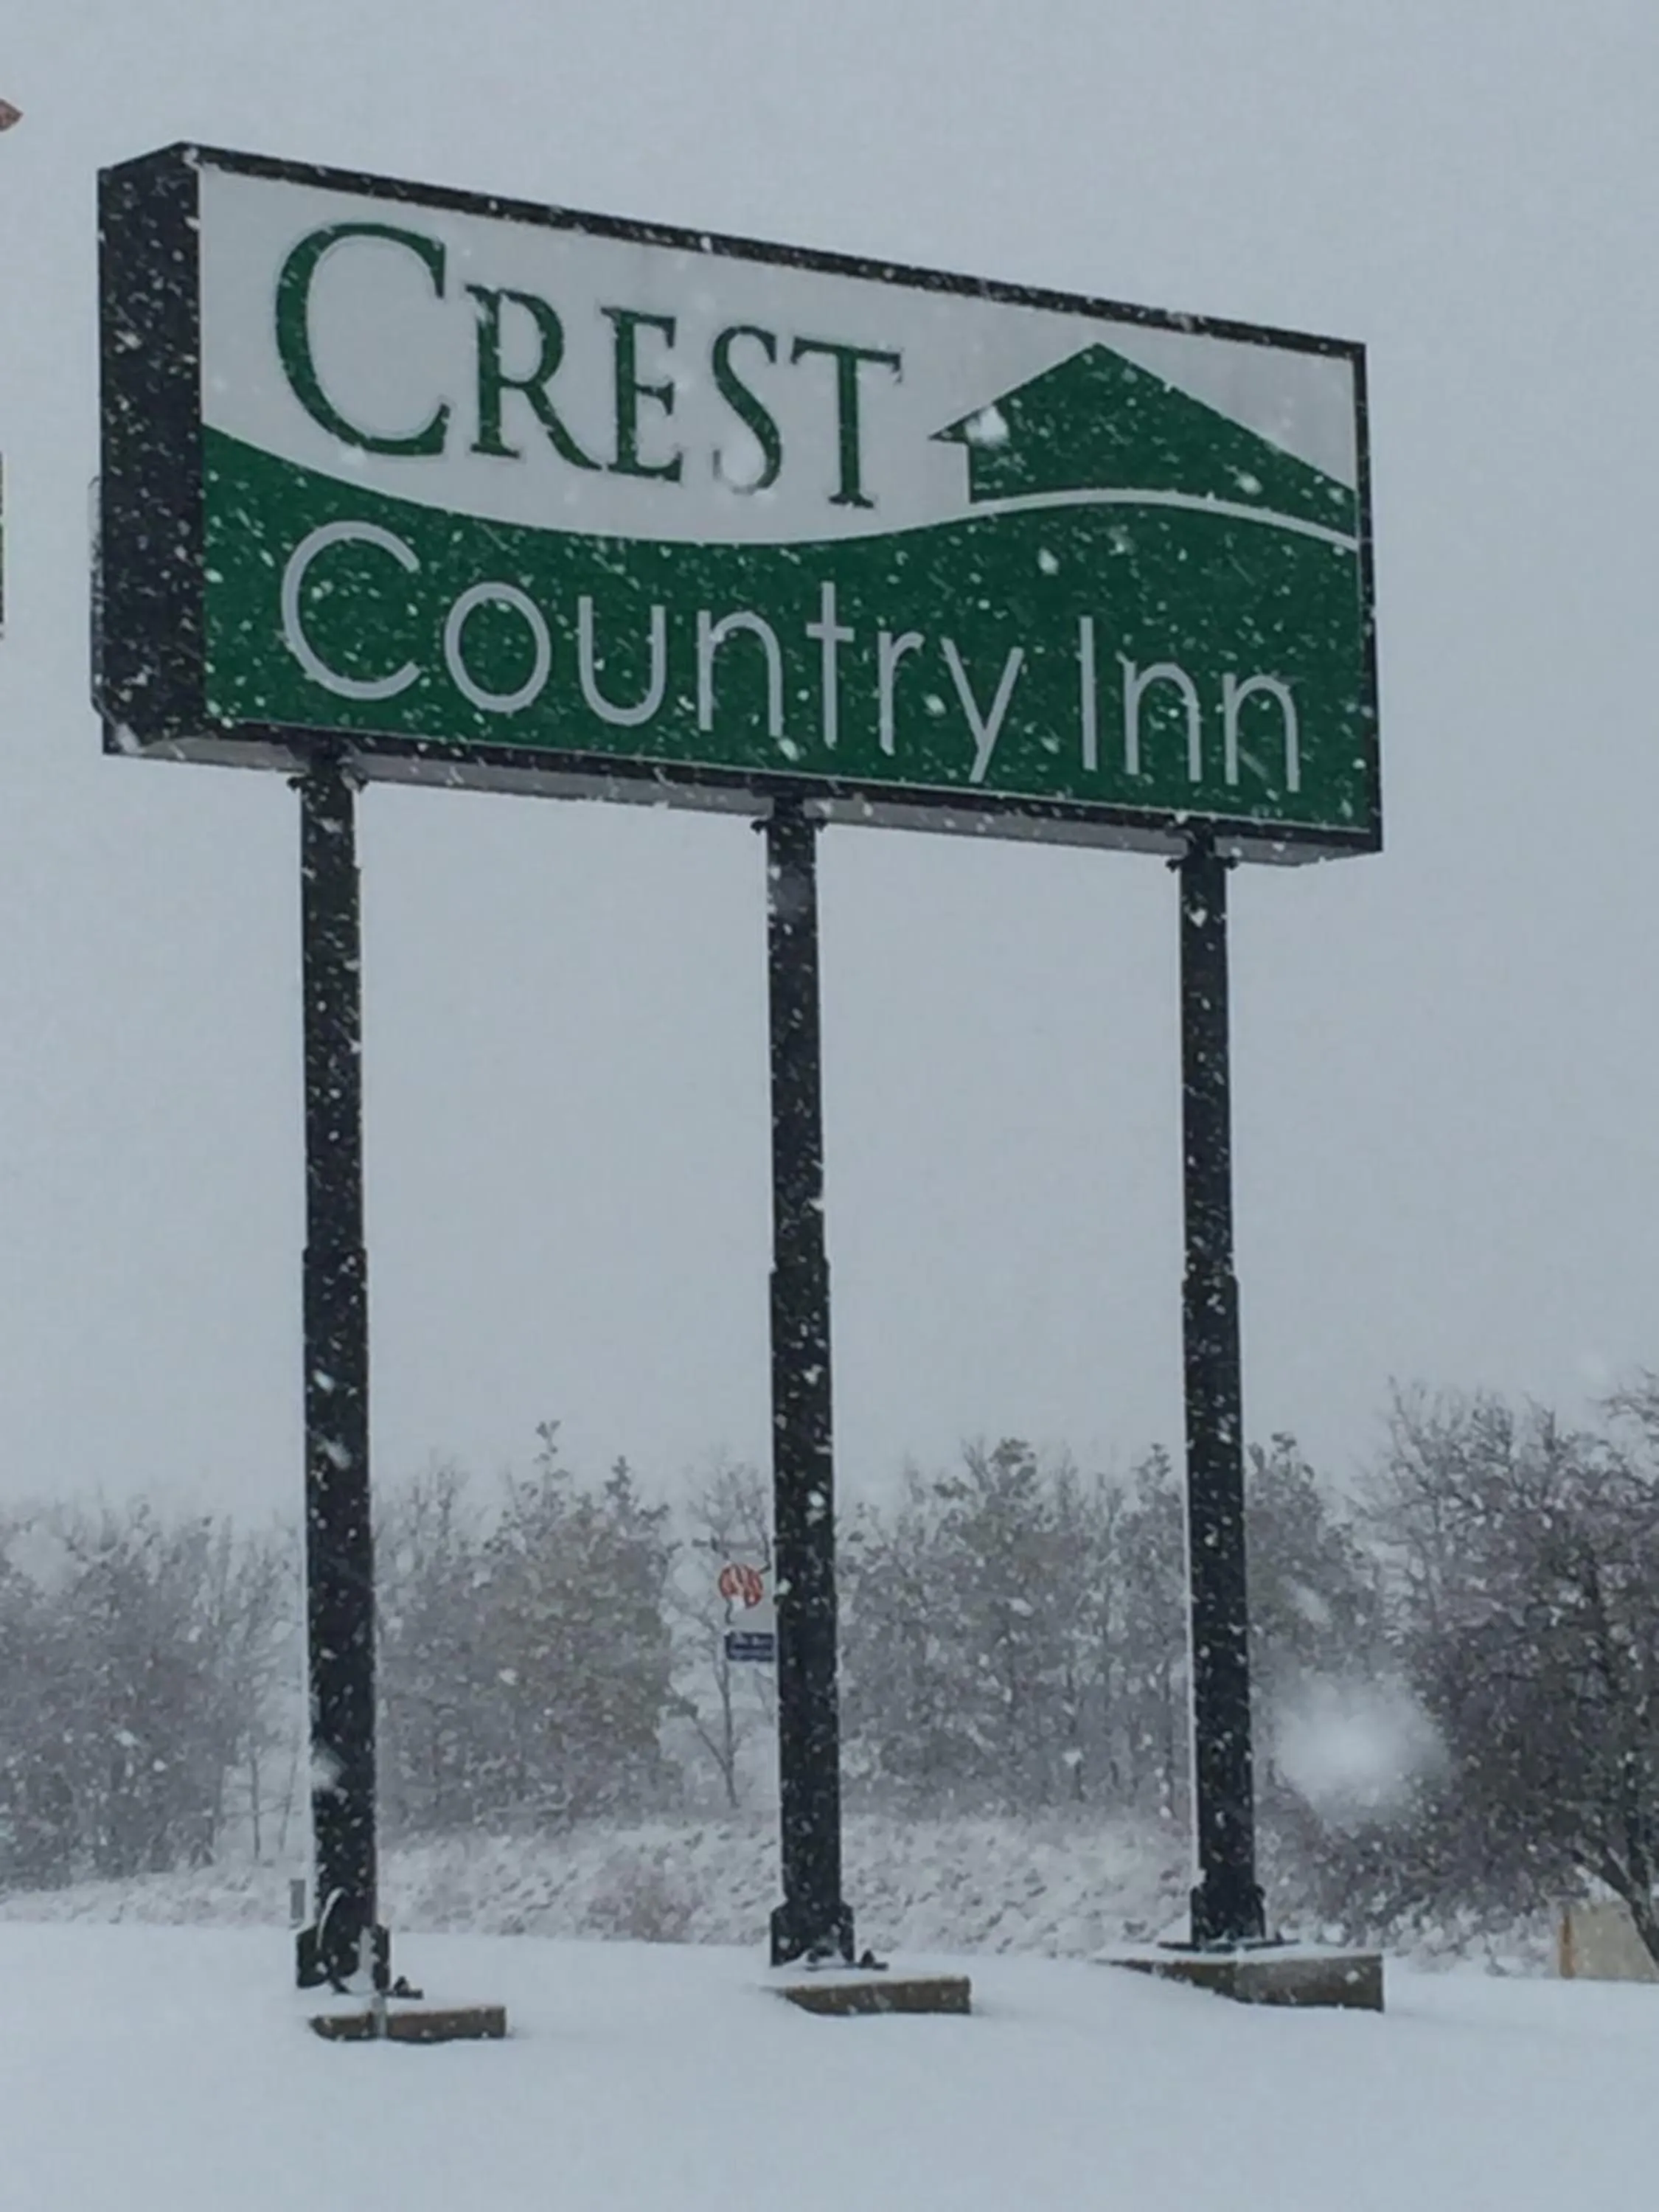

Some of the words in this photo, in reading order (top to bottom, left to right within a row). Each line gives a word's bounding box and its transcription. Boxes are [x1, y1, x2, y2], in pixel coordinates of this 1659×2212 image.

[275, 221, 902, 509] CREST
[281, 520, 1024, 783] Country
[1079, 616, 1301, 793] Inn
